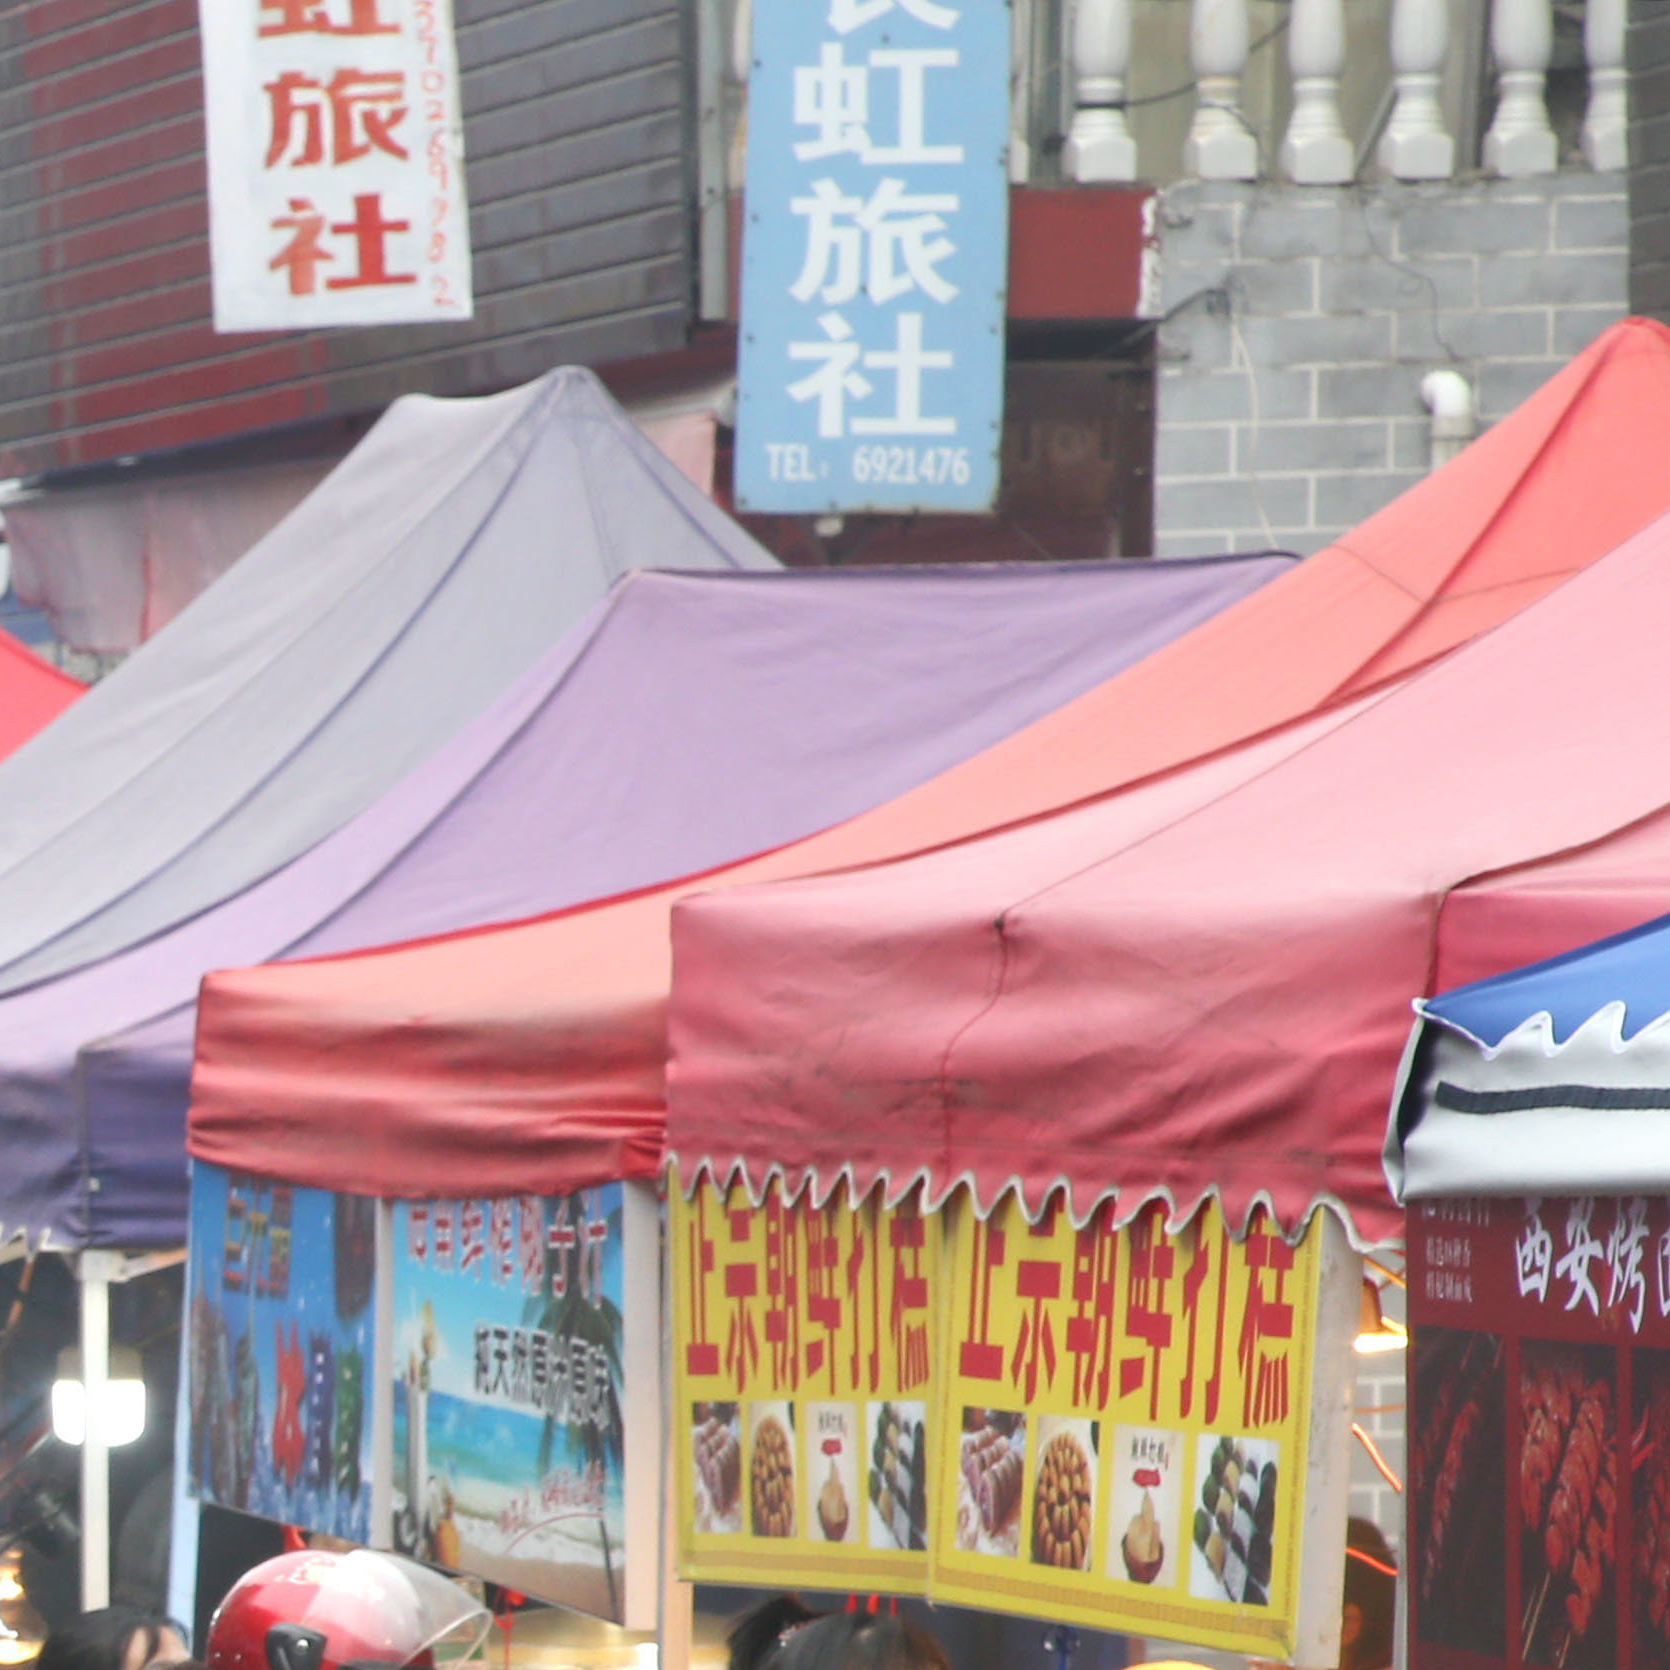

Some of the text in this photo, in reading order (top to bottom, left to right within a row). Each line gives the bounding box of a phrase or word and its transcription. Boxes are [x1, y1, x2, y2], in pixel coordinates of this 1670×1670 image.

[785, 0, 964, 439] 虹旅社
[852, 445, 969, 485] 6921476
[1513, 1196, 1670, 1336] 西安烤
